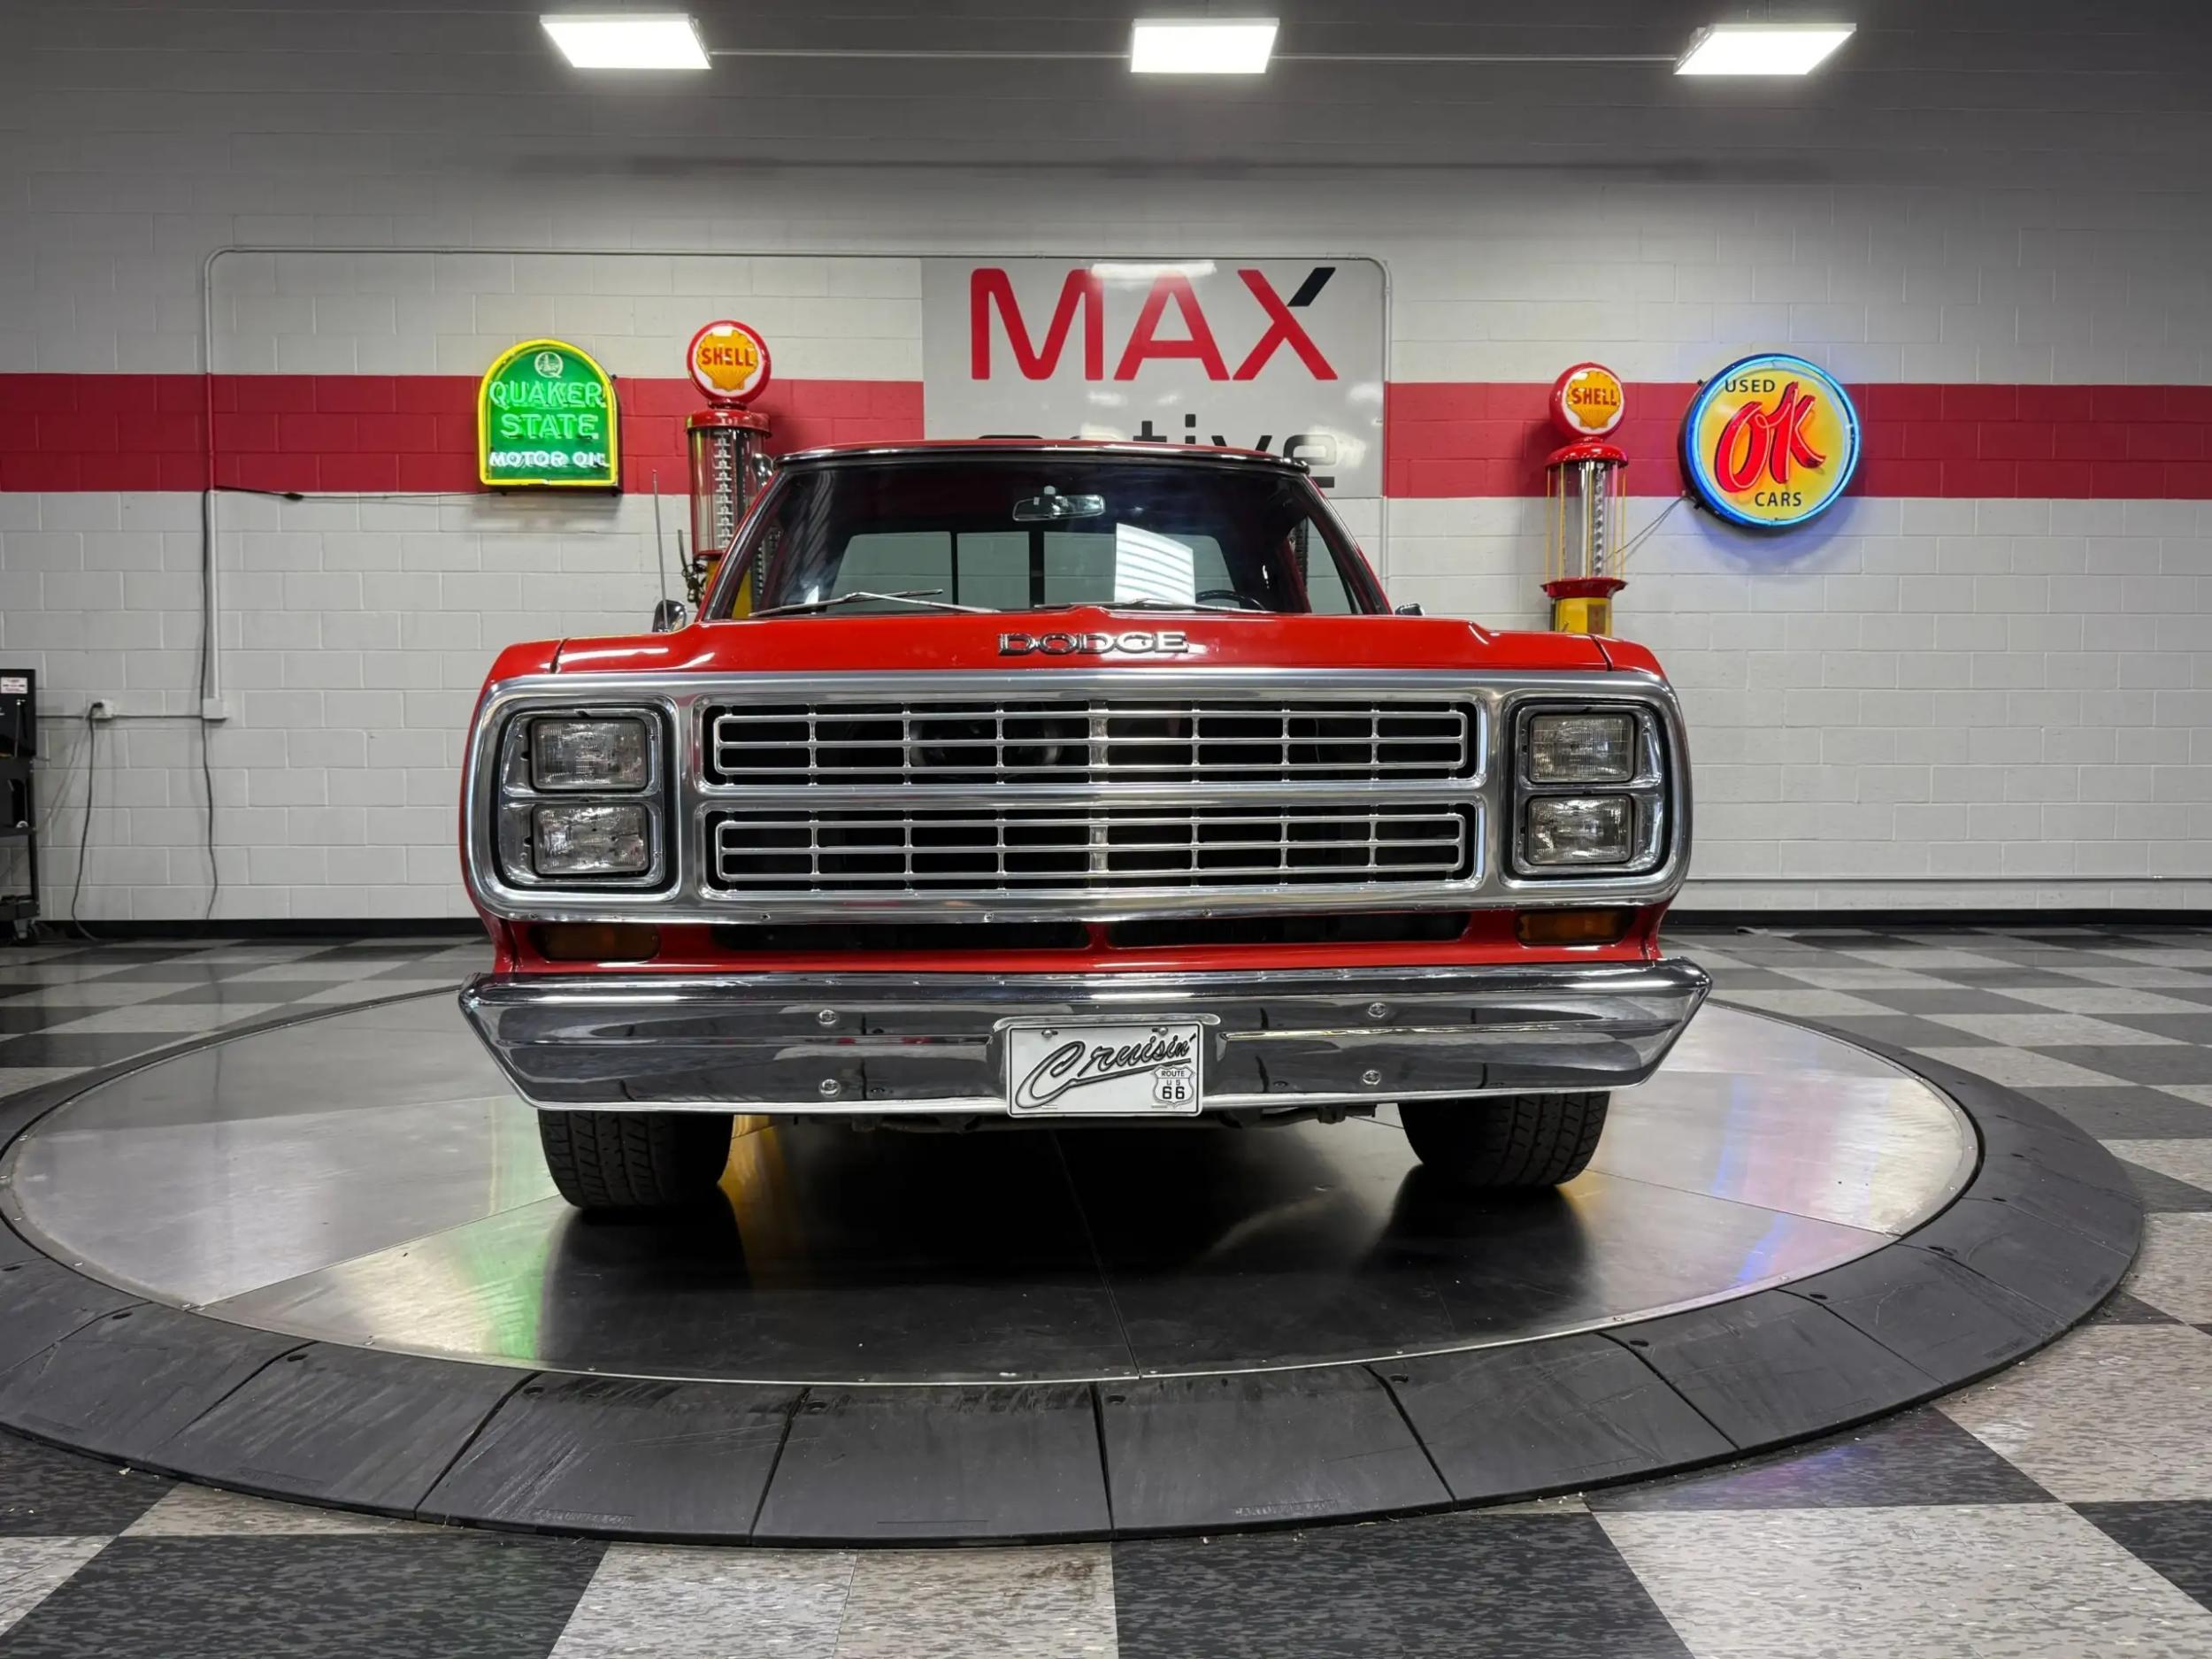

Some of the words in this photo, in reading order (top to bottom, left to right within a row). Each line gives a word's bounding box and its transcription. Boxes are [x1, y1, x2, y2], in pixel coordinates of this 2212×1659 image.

[971, 267, 1338, 381] MAX
[701, 346, 756, 368] SHELL
[488, 380, 607, 411] QUAKER
[1725, 379, 1776, 393] USED
[1571, 388, 1617, 407] SHELL
[500, 413, 599, 440] STATE
[1715, 381, 1826, 492] OK
[488, 450, 569, 468] MOTOR
[572, 451, 610, 468] OIL
[1755, 492, 1802, 507] CARS
[998, 631, 1188, 656] DODGE
[1162, 1086, 1186, 1100] 66
